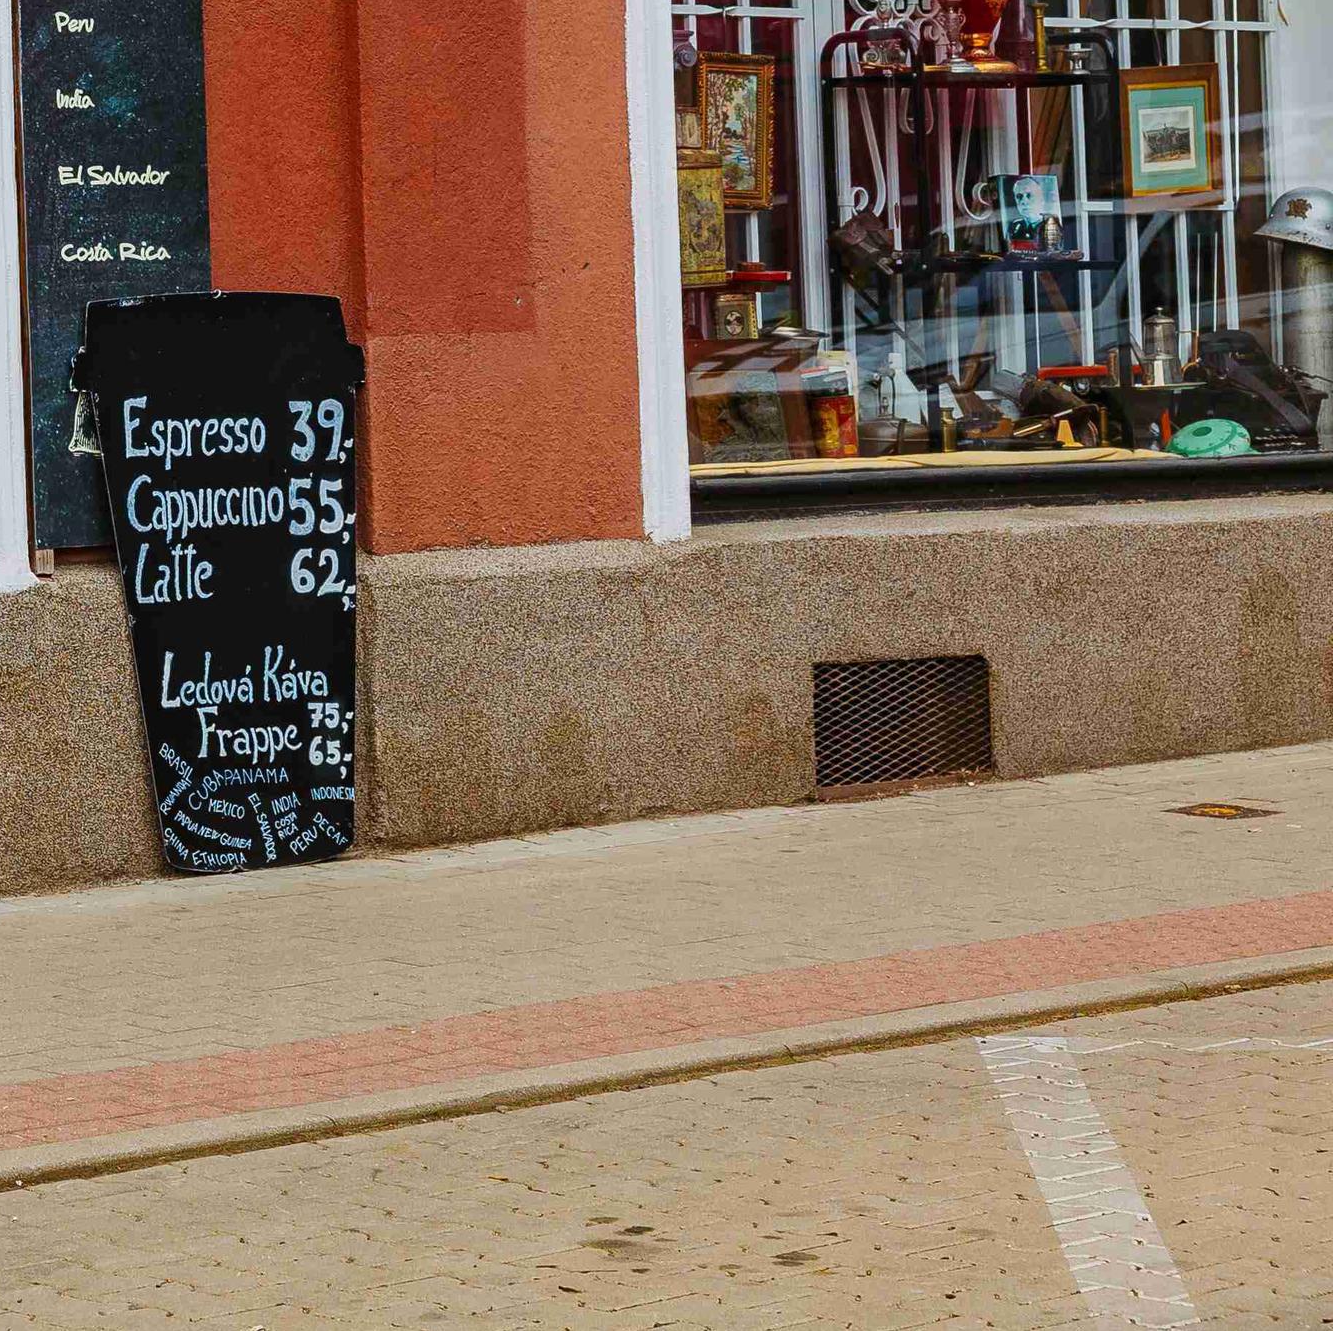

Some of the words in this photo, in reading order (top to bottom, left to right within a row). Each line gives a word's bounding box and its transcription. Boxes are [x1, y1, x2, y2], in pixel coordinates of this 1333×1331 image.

[54, 11, 95, 33] Peru
[56, 88, 95, 110] India
[58, 166, 84, 186] El
[87, 165, 171, 186] Salvador
[60, 243, 113, 262] Costa
[119, 241, 172, 262] Rica
[123, 395, 266, 470] Espresso
[126, 474, 284, 544] Cappuccino
[135, 542, 214, 604] Latte
[160, 650, 254, 709] Ledová
[263, 644, 329, 704] Káva
[196, 705, 303, 765] Frappe
[158, 742, 194, 784] BRASIL
[224, 766, 290, 786] PANAMA
[188, 769, 224, 810] CUBA
[271, 791, 302, 816] INDIA
[208, 798, 245, 820] MEXICO
[274, 811, 298, 830] COSTA
[164, 827, 190, 861] CHINA
[174, 810, 199, 834] PAPUA
[197, 825, 220, 840] NEW
[219, 832, 253, 850] GUINEA
[247, 792, 262, 814] EL
[256, 813, 277, 864] SALVADOR
[277, 823, 299, 841] RICA
[289, 825, 318, 856] PERU
[313, 811, 349, 846] DECAF
[191, 850, 248, 867] ETHIOPIA
